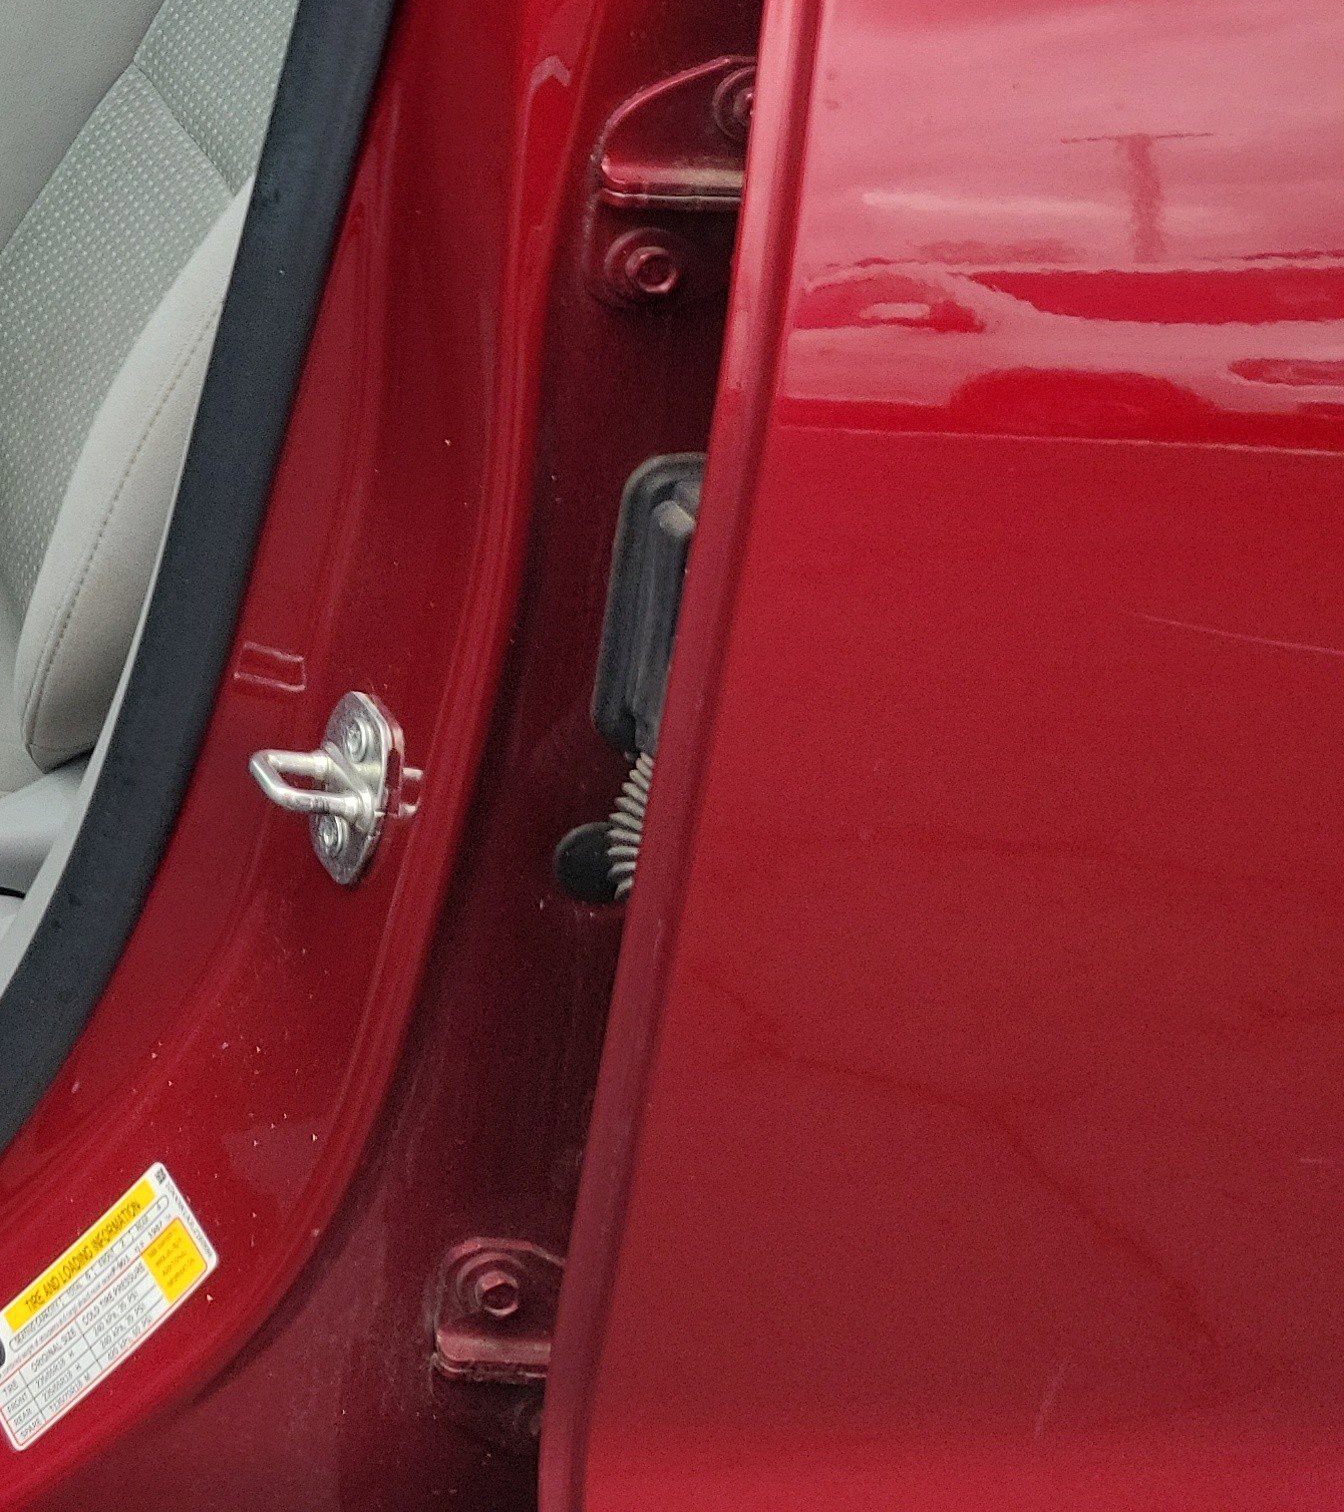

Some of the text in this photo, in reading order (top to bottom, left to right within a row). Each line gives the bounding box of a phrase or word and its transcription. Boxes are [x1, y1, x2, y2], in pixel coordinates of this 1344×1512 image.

[24, 1288, 45, 1315] TIRE
[41, 1274, 61, 1299] AND
[56, 1243, 94, 1285] LOADING
[88, 1197, 142, 1253] INFORMATION
[29, 1338, 62, 1374] ORIGINAL
[60, 1325, 77, 1346] SIZE
